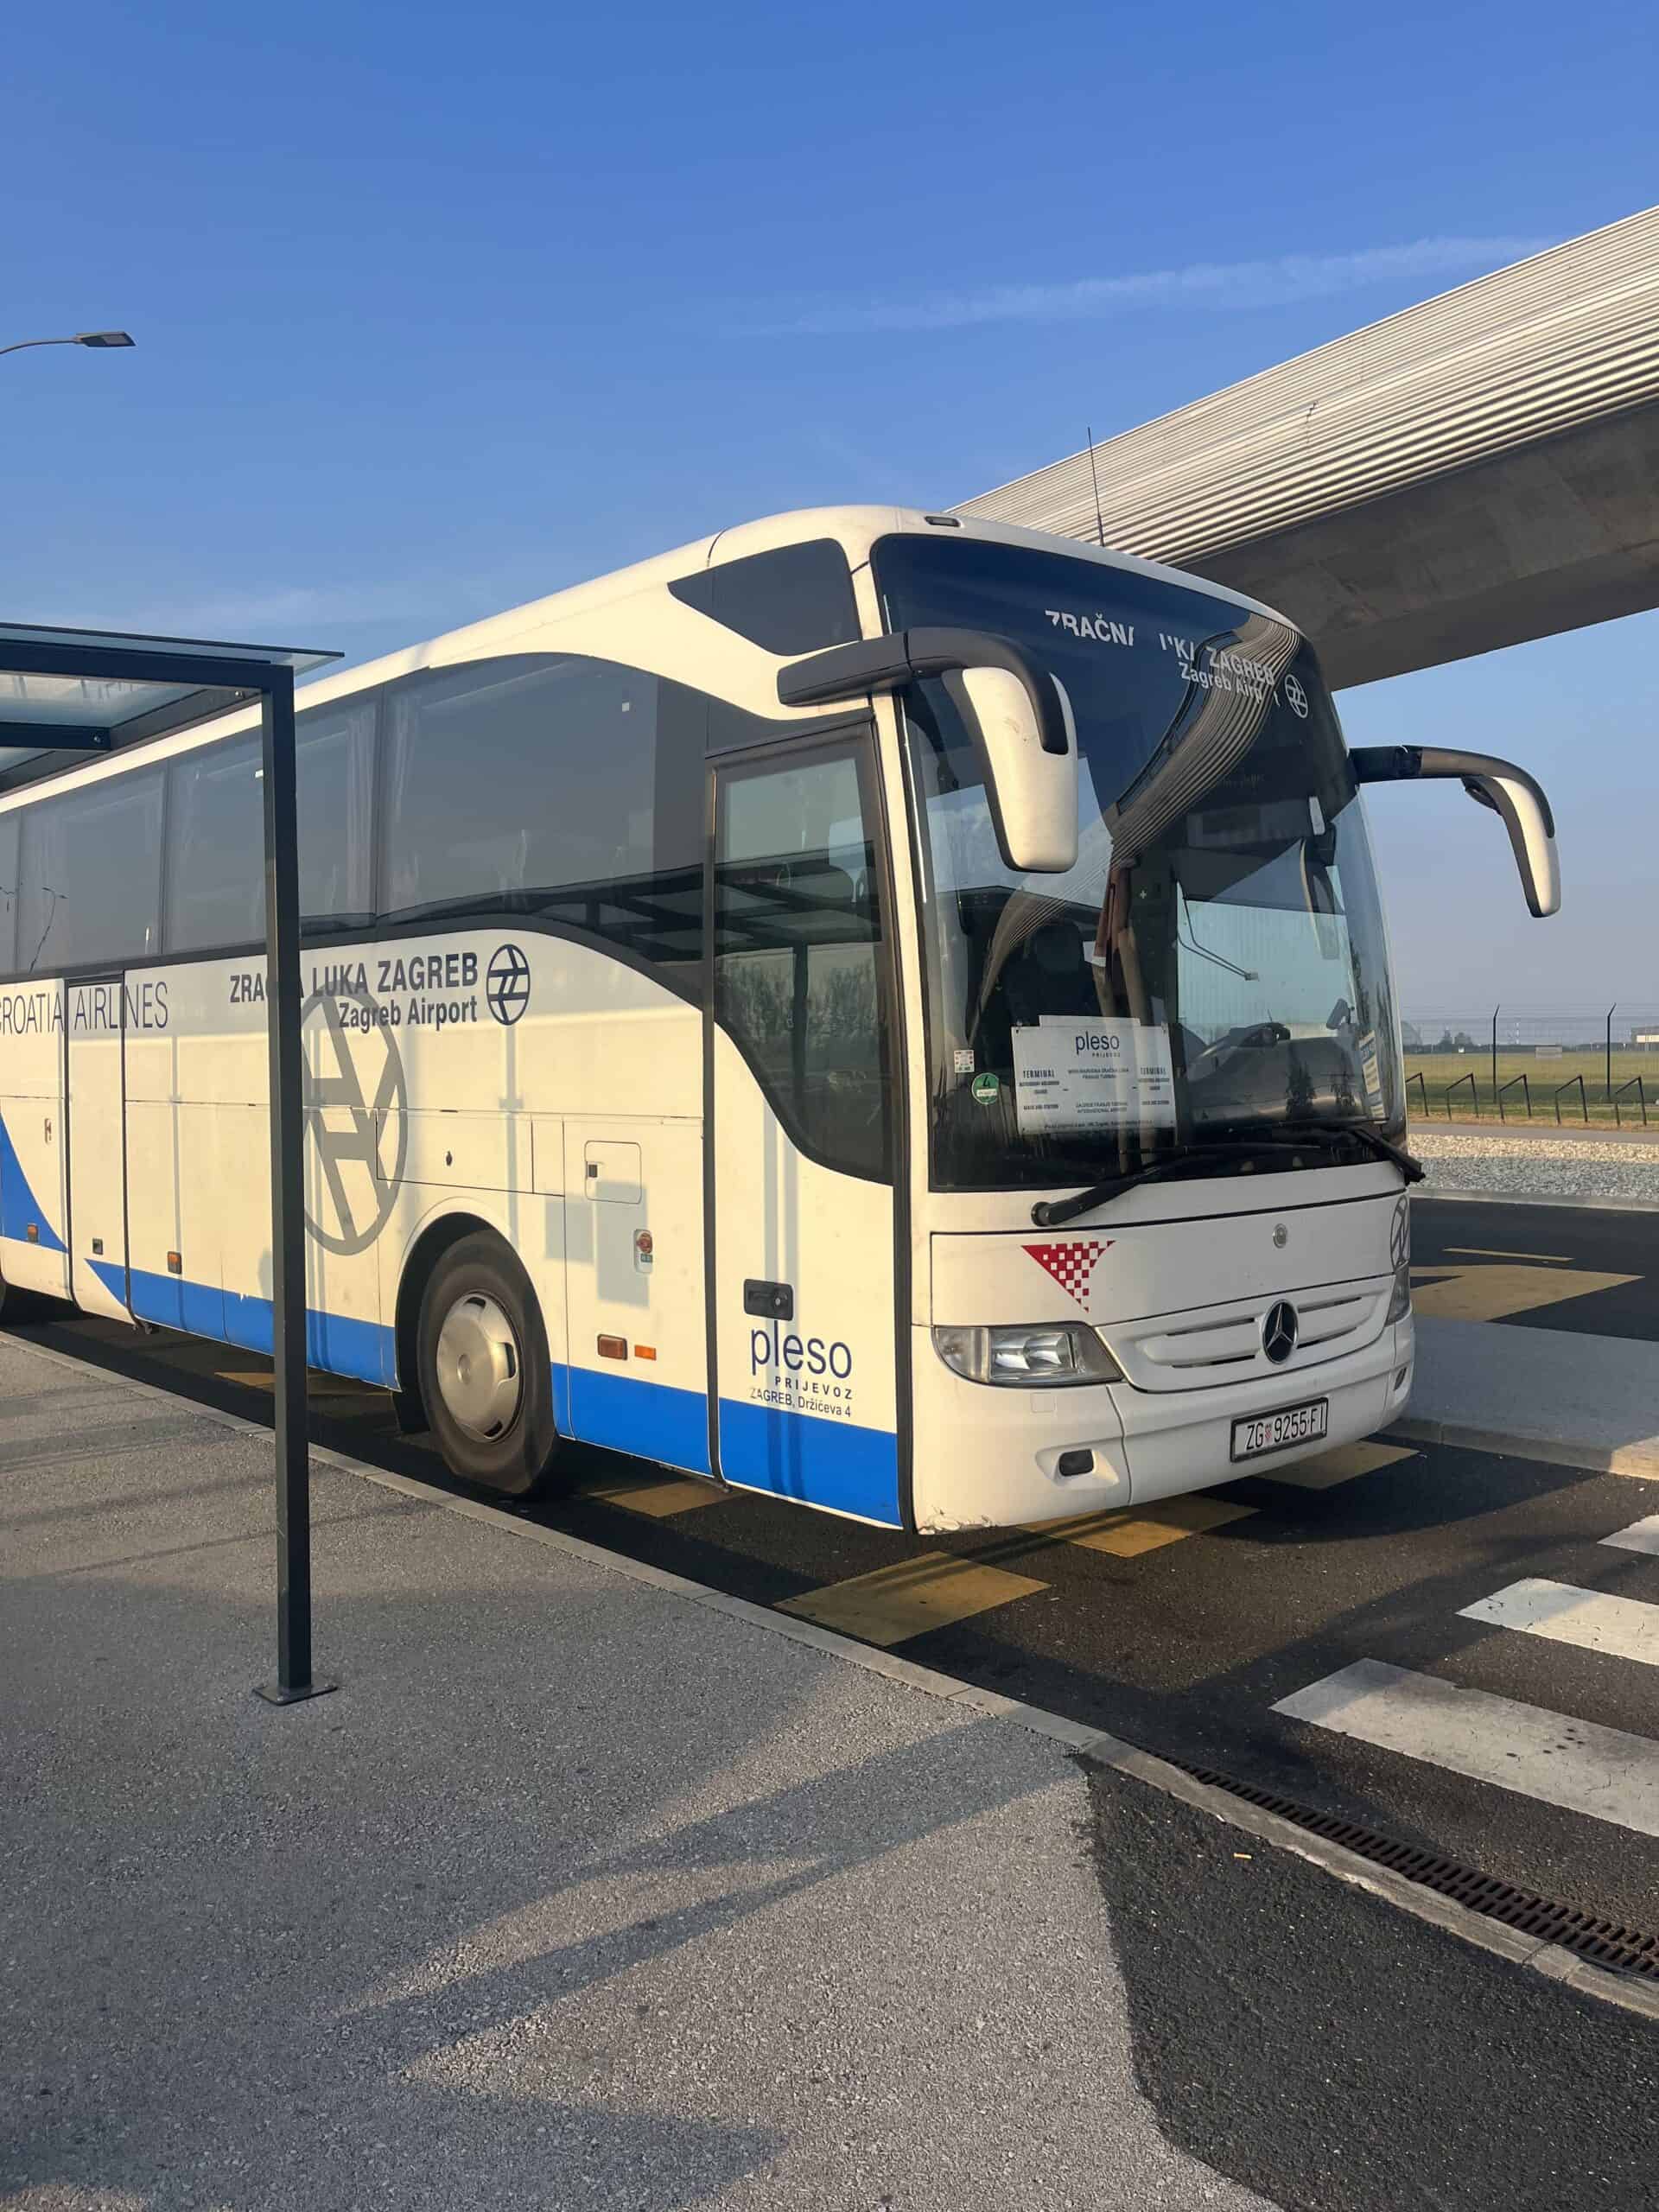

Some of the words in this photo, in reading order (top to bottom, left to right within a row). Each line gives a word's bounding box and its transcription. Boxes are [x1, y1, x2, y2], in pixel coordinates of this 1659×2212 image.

[1179, 661, 1231, 691] Zagreb
[312, 962, 369, 997] LUKA
[378, 951, 478, 993] ZAGREB
[0, 992, 65, 1035] ROATIA
[74, 981, 168, 1031] AIRLINES
[339, 997, 401, 1034] Zagreb
[408, 995, 478, 1032] Airport
[1076, 1030, 1120, 1055] pleso
[751, 1319, 852, 1379] pleso
[774, 1376, 853, 1400] PRIJEVOZ
[844, 1405, 852, 1418] 4
[1246, 1422, 1264, 1450] ZG
